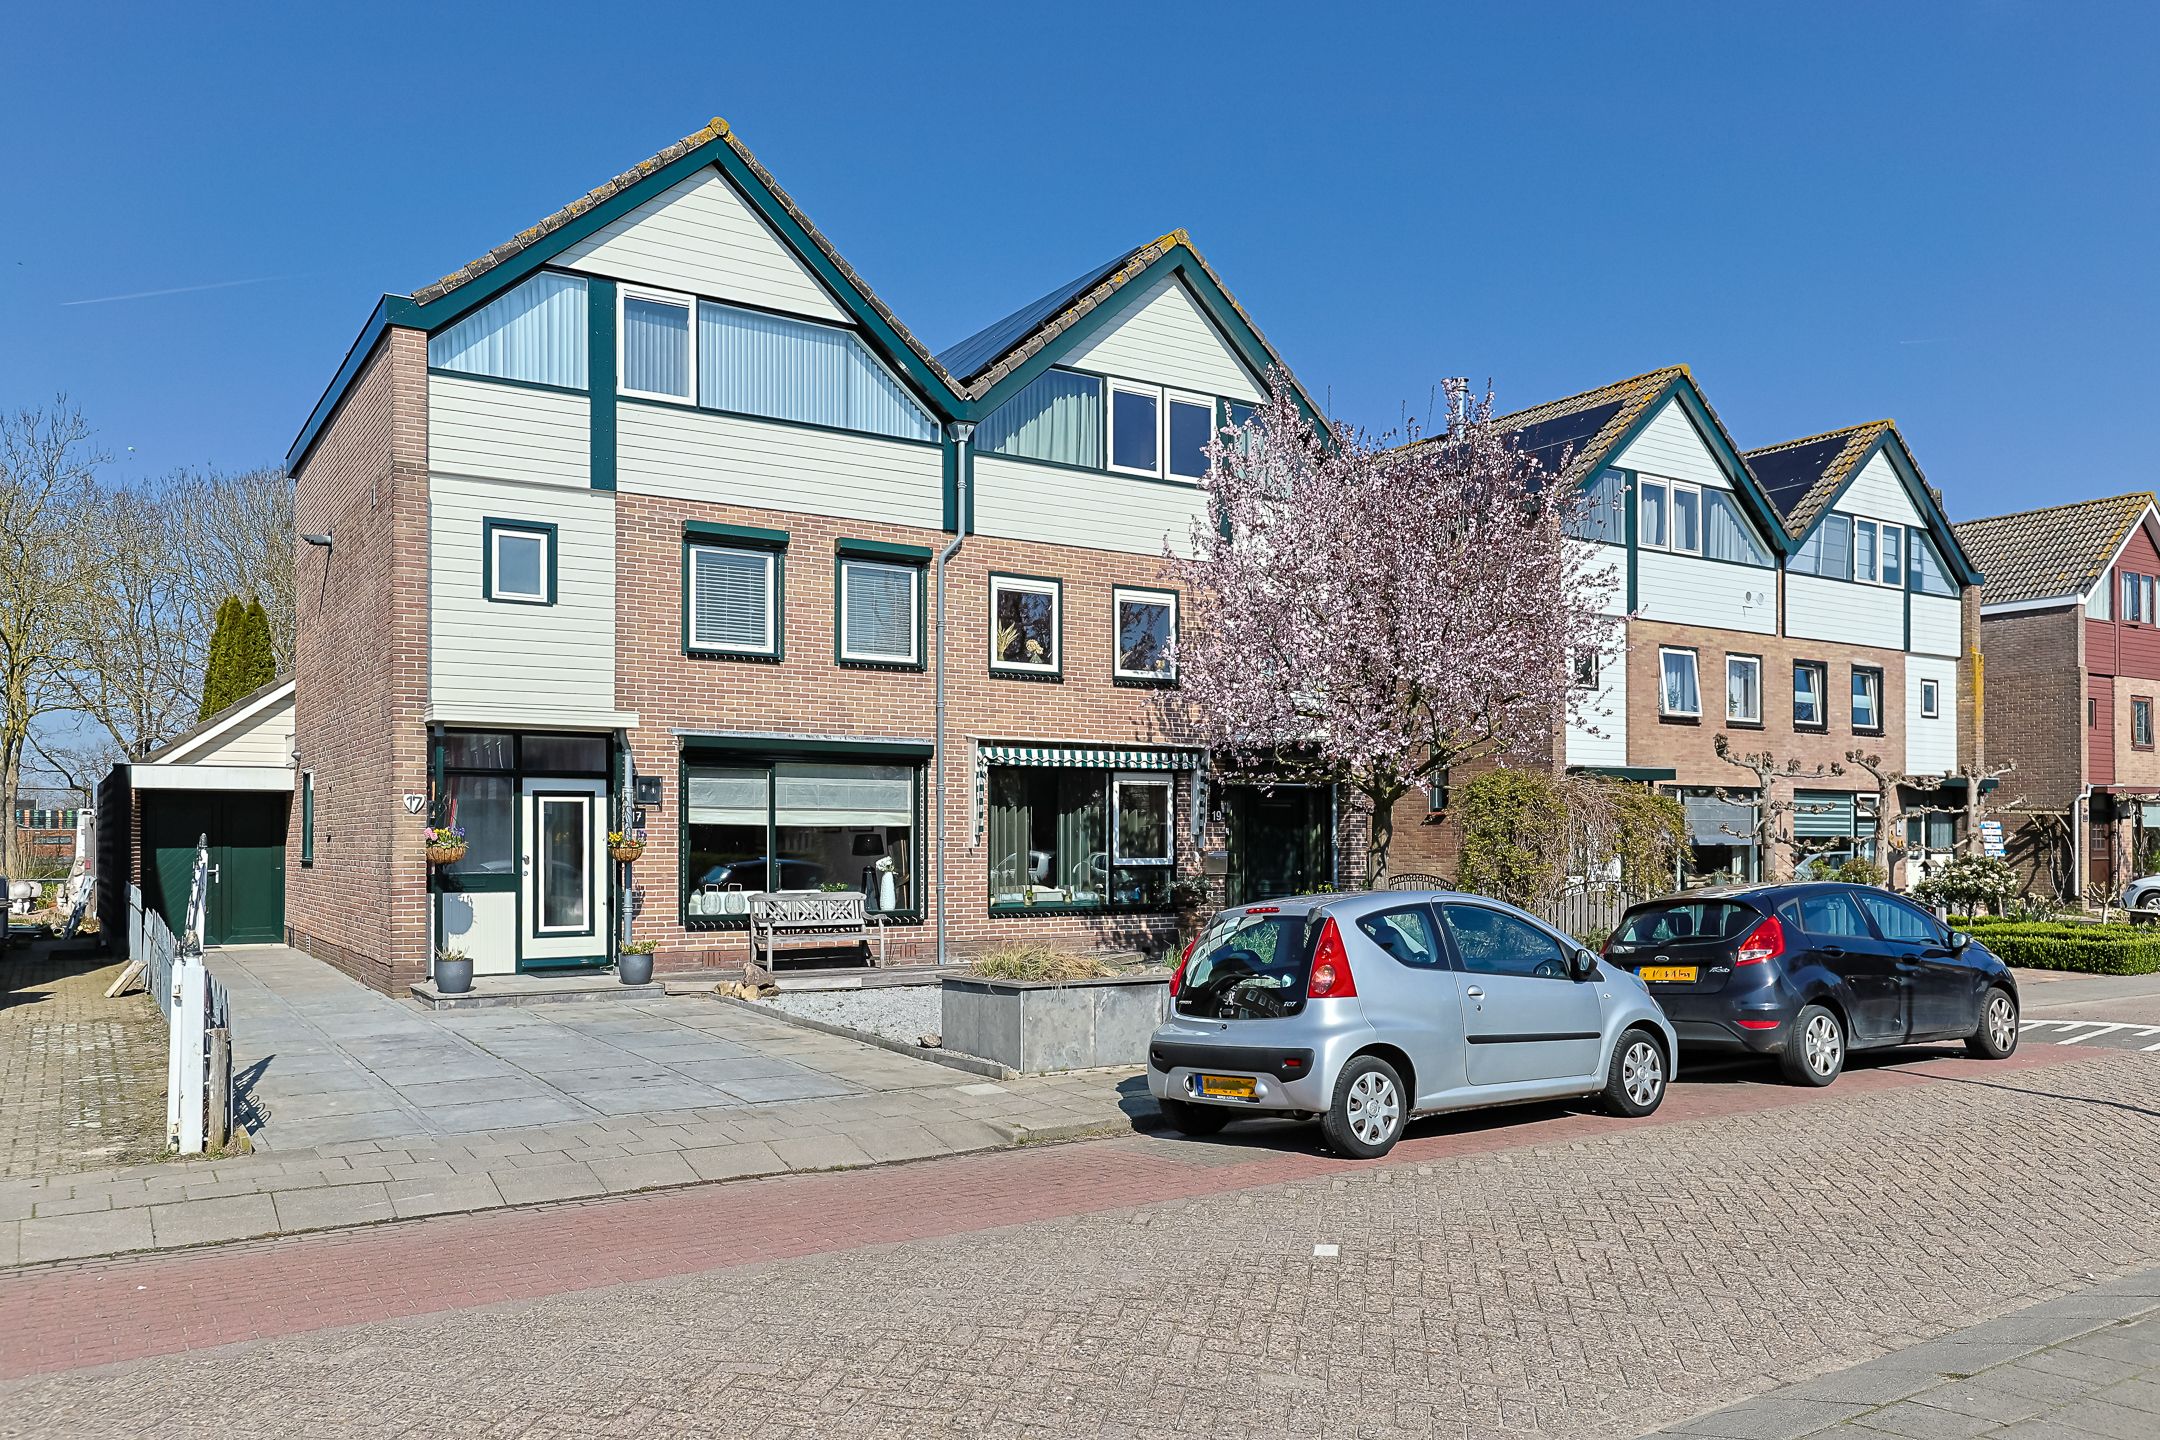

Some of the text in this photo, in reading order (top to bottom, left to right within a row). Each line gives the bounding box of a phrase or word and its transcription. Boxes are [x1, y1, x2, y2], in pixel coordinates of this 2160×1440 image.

[406, 795, 423, 811] 17
[632, 811, 642, 822] 17
[1211, 810, 1222, 821] 19
